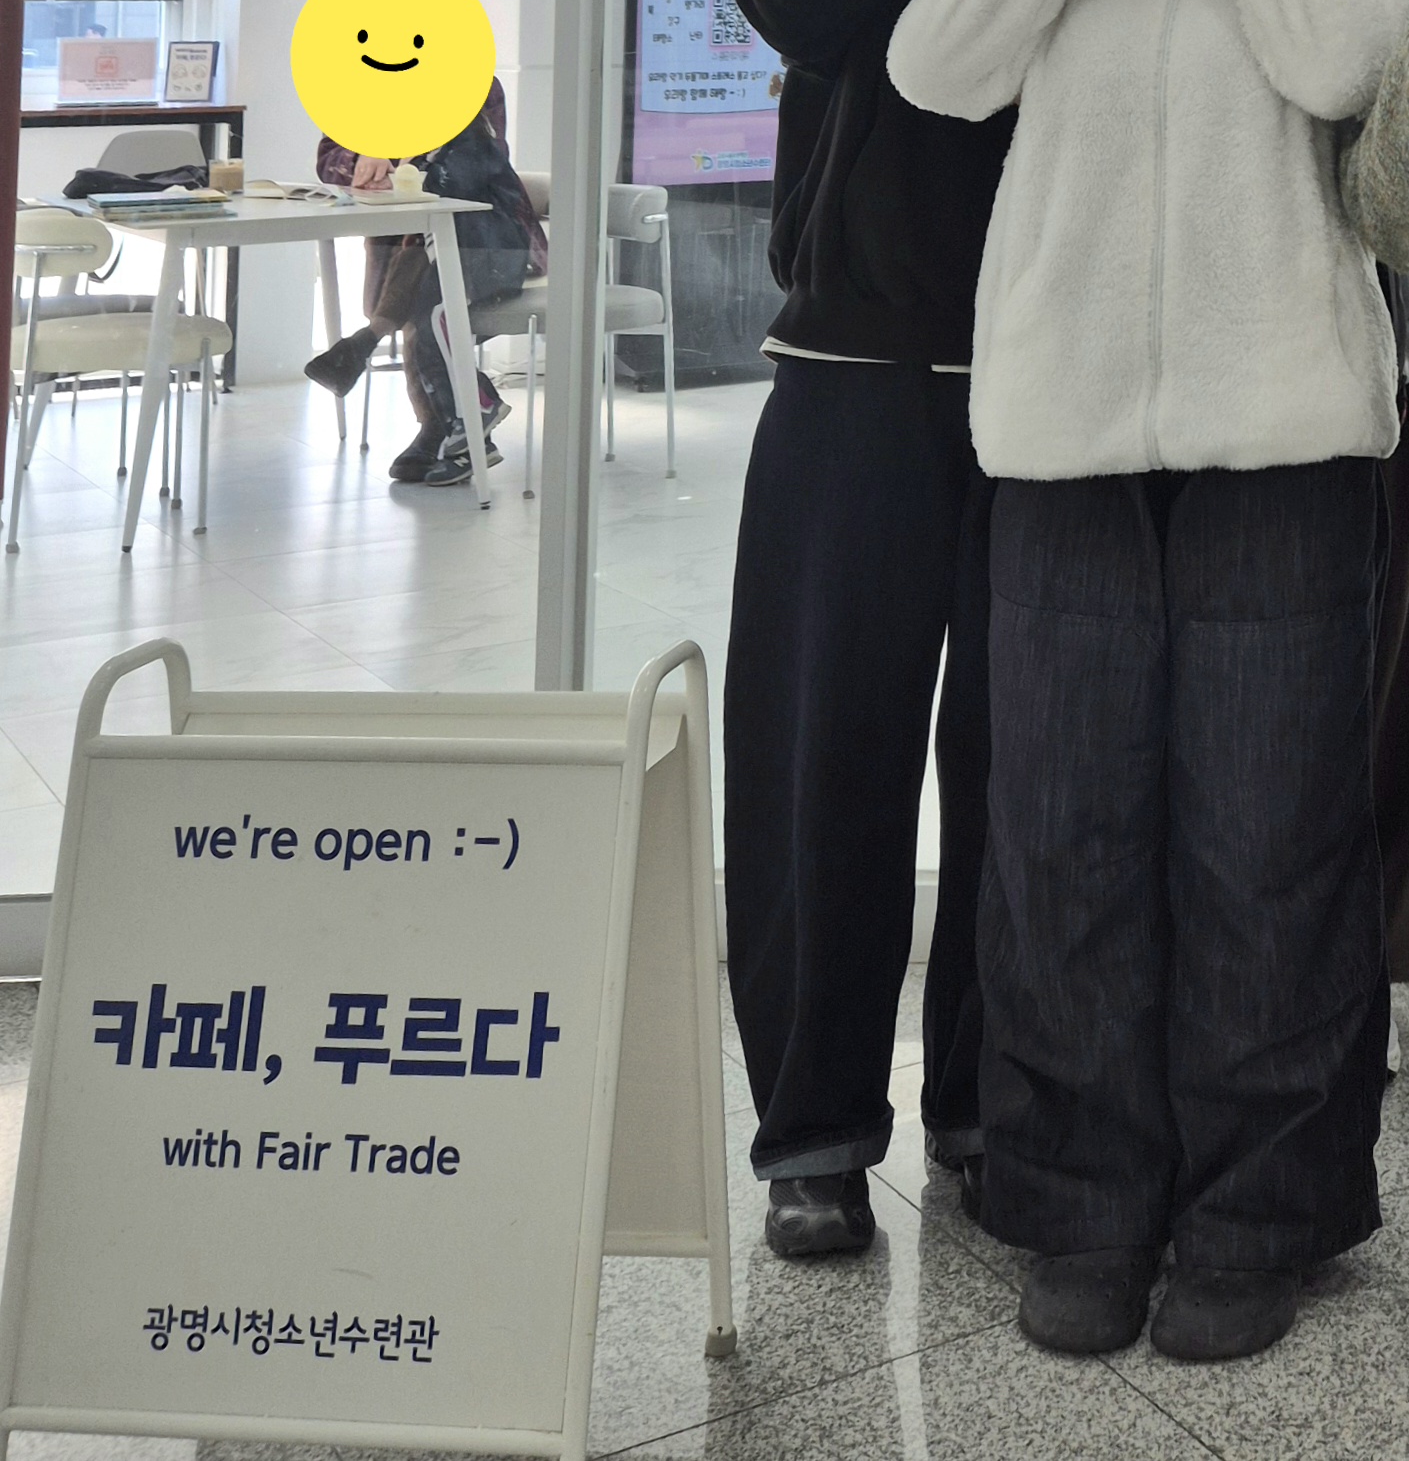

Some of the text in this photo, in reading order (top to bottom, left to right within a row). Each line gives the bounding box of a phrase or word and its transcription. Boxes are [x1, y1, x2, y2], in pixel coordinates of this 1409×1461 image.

[174, 813, 299, 860] we're
[314, 827, 431, 872] open
[91, 983, 561, 1086] 카페, 푸르다
[162, 1128, 461, 1176] with Fair Trade
[142, 1303, 440, 1364] 광명시청소년수련관
